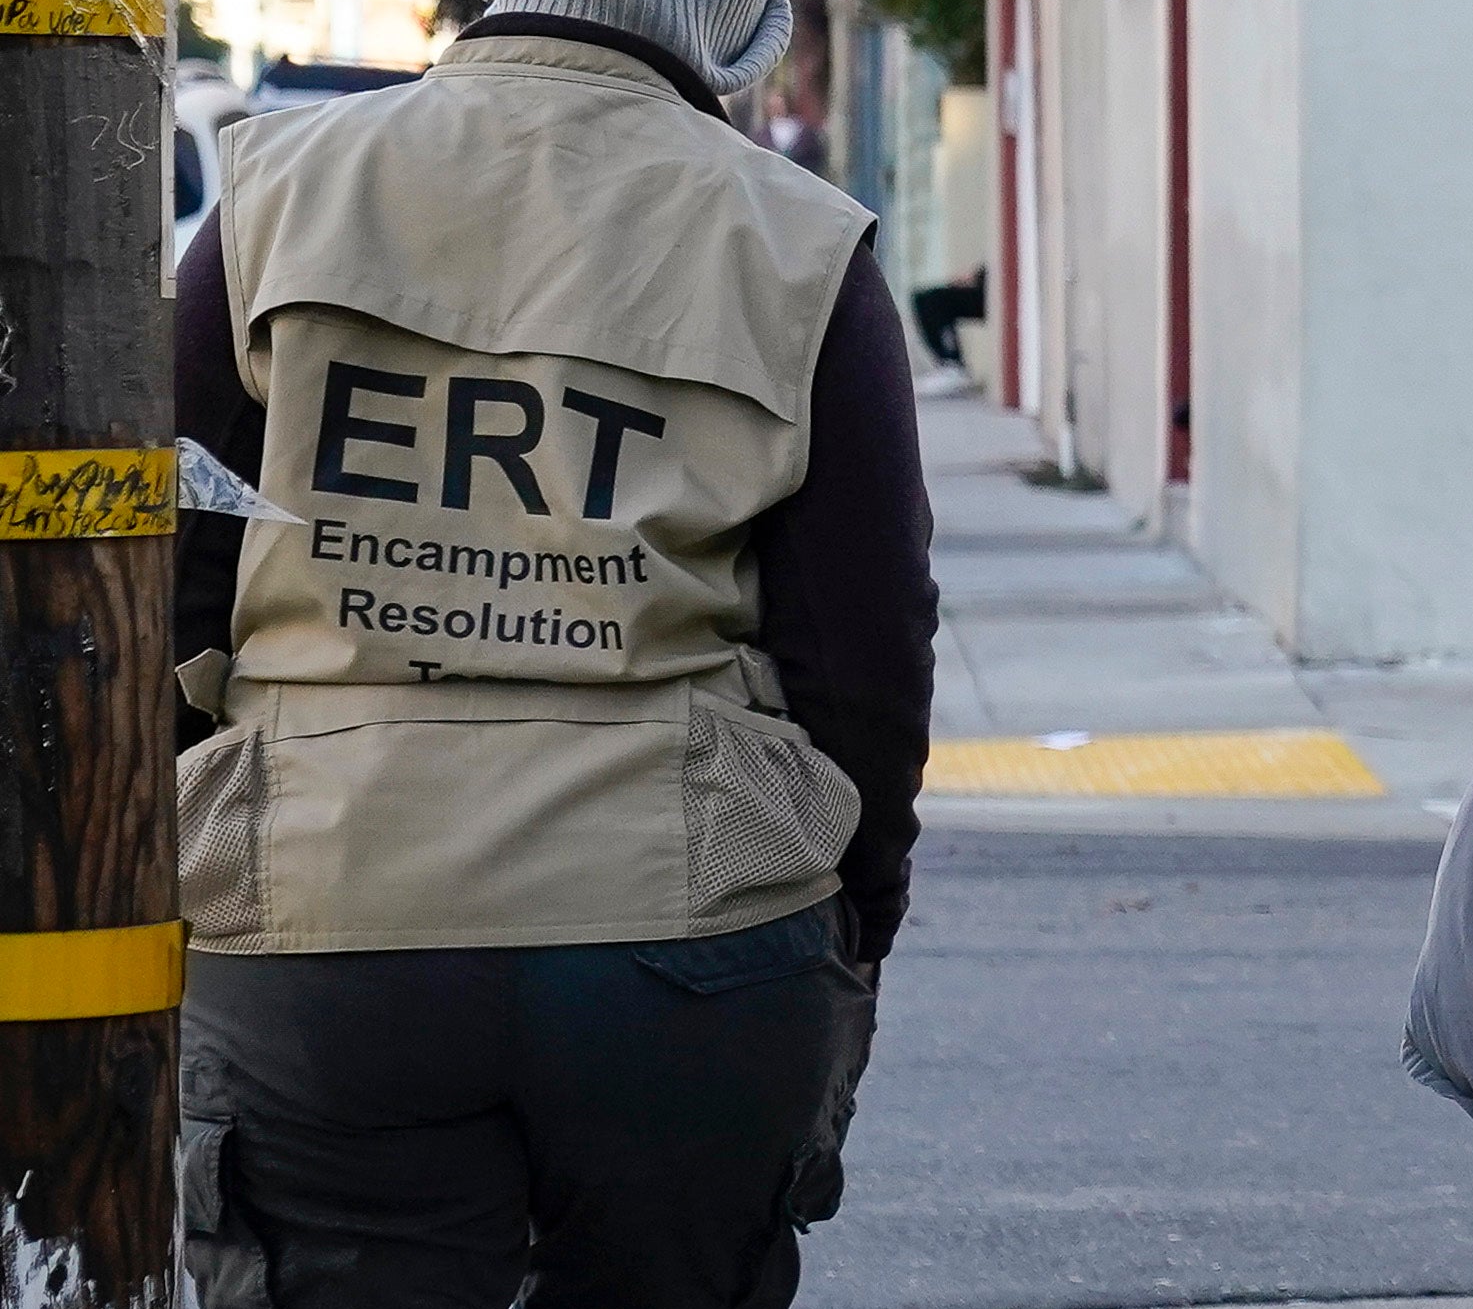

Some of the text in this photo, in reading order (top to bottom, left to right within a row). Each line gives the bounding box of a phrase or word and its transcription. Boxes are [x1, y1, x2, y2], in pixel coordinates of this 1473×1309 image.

[311, 360, 666, 520] ERT
[311, 518, 648, 590] Encampment
[338, 587, 623, 650] Resolution
